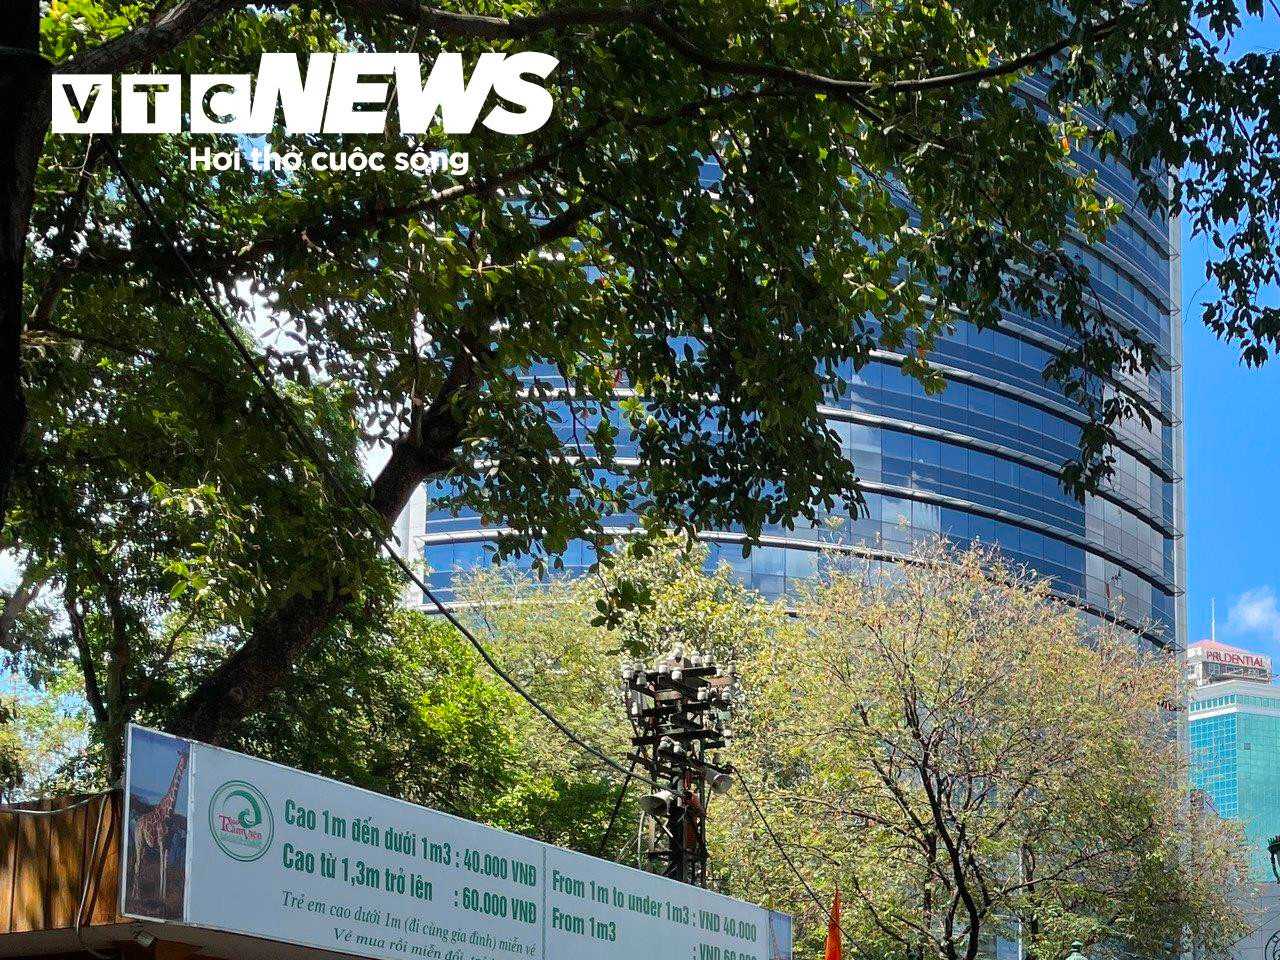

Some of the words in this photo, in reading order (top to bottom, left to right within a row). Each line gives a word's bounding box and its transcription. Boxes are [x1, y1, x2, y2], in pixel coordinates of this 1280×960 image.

[1206, 651, 1265, 668] PRUDENTIAL
[284, 798, 317, 831] Cao
[322, 810, 347, 839] 1m
[352, 816, 380, 847] đến
[384, 827, 417, 857] dưới
[421, 837, 451, 866] 1m3
[463, 848, 508, 880] 40.000
[511, 859, 537, 887] VNĐ
[282, 842, 315, 874] Cao
[320, 852, 338, 879] từ
[341, 857, 380, 889] 1,3m
[385, 867, 406, 895] trở
[410, 873, 433, 901] lên
[462, 886, 508, 918] 60.000
[511, 897, 537, 924] VNĐ
[552, 869, 586, 898] From
[590, 880, 609, 905] 1m
[613, 886, 625, 909] to
[628, 894, 663, 919] under
[665, 901, 690, 926] 1m3
[700, 909, 720, 933] VND
[723, 916, 757, 943] 40.000
[282, 890, 305, 909] Trẻ
[307, 899, 326, 915] em
[329, 904, 351, 919] cao
[354, 906, 381, 925] dưới
[385, 912, 401, 930] 1m
[422, 921, 449, 943] cùng
[451, 928, 467, 945] gia
[469, 930, 497, 952] đình)
[499, 936, 523, 955] miễn
[525, 942, 537, 957] vé
[333, 927, 352, 942] Vé
[356, 934, 385, 949] mua
[389, 937, 408, 952] rồi
[411, 943, 442, 960] miễn
[552, 906, 585, 936] From
[589, 916, 617, 942] 1m3
